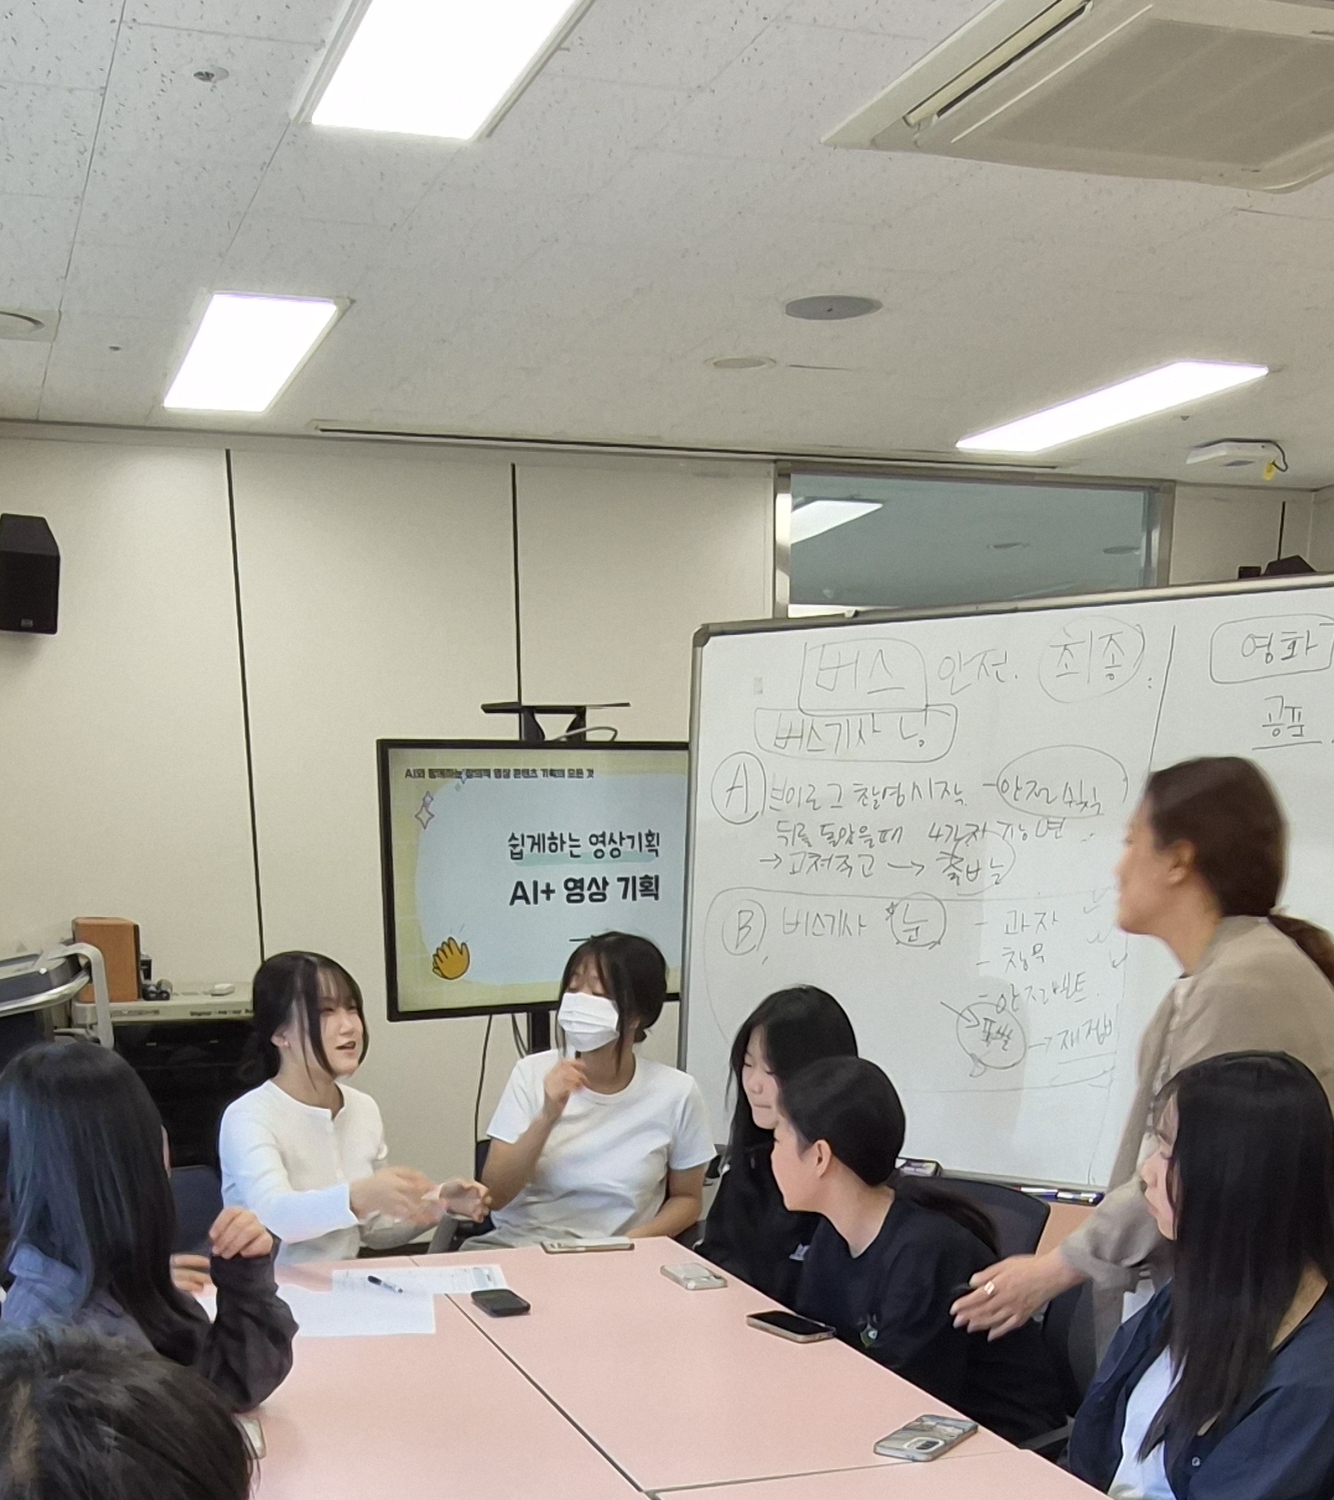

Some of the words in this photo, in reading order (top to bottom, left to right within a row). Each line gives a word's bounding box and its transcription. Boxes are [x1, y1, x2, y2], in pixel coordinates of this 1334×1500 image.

[1241, 627, 1322, 665] 영화
[815, 643, 906, 695] 버스
[773, 712, 882, 754] 버스기사
[724, 762, 750, 814] A
[507, 830, 582, 861] 쉽게하는
[588, 828, 661, 860] 영상기획
[508, 879, 556, 906] AI+
[563, 876, 609, 904] 영상
[616, 873, 660, 902] 기획
[734, 909, 755, 949] B
[781, 906, 868, 938] 버스기사
[1003, 909, 1059, 935] 과자
